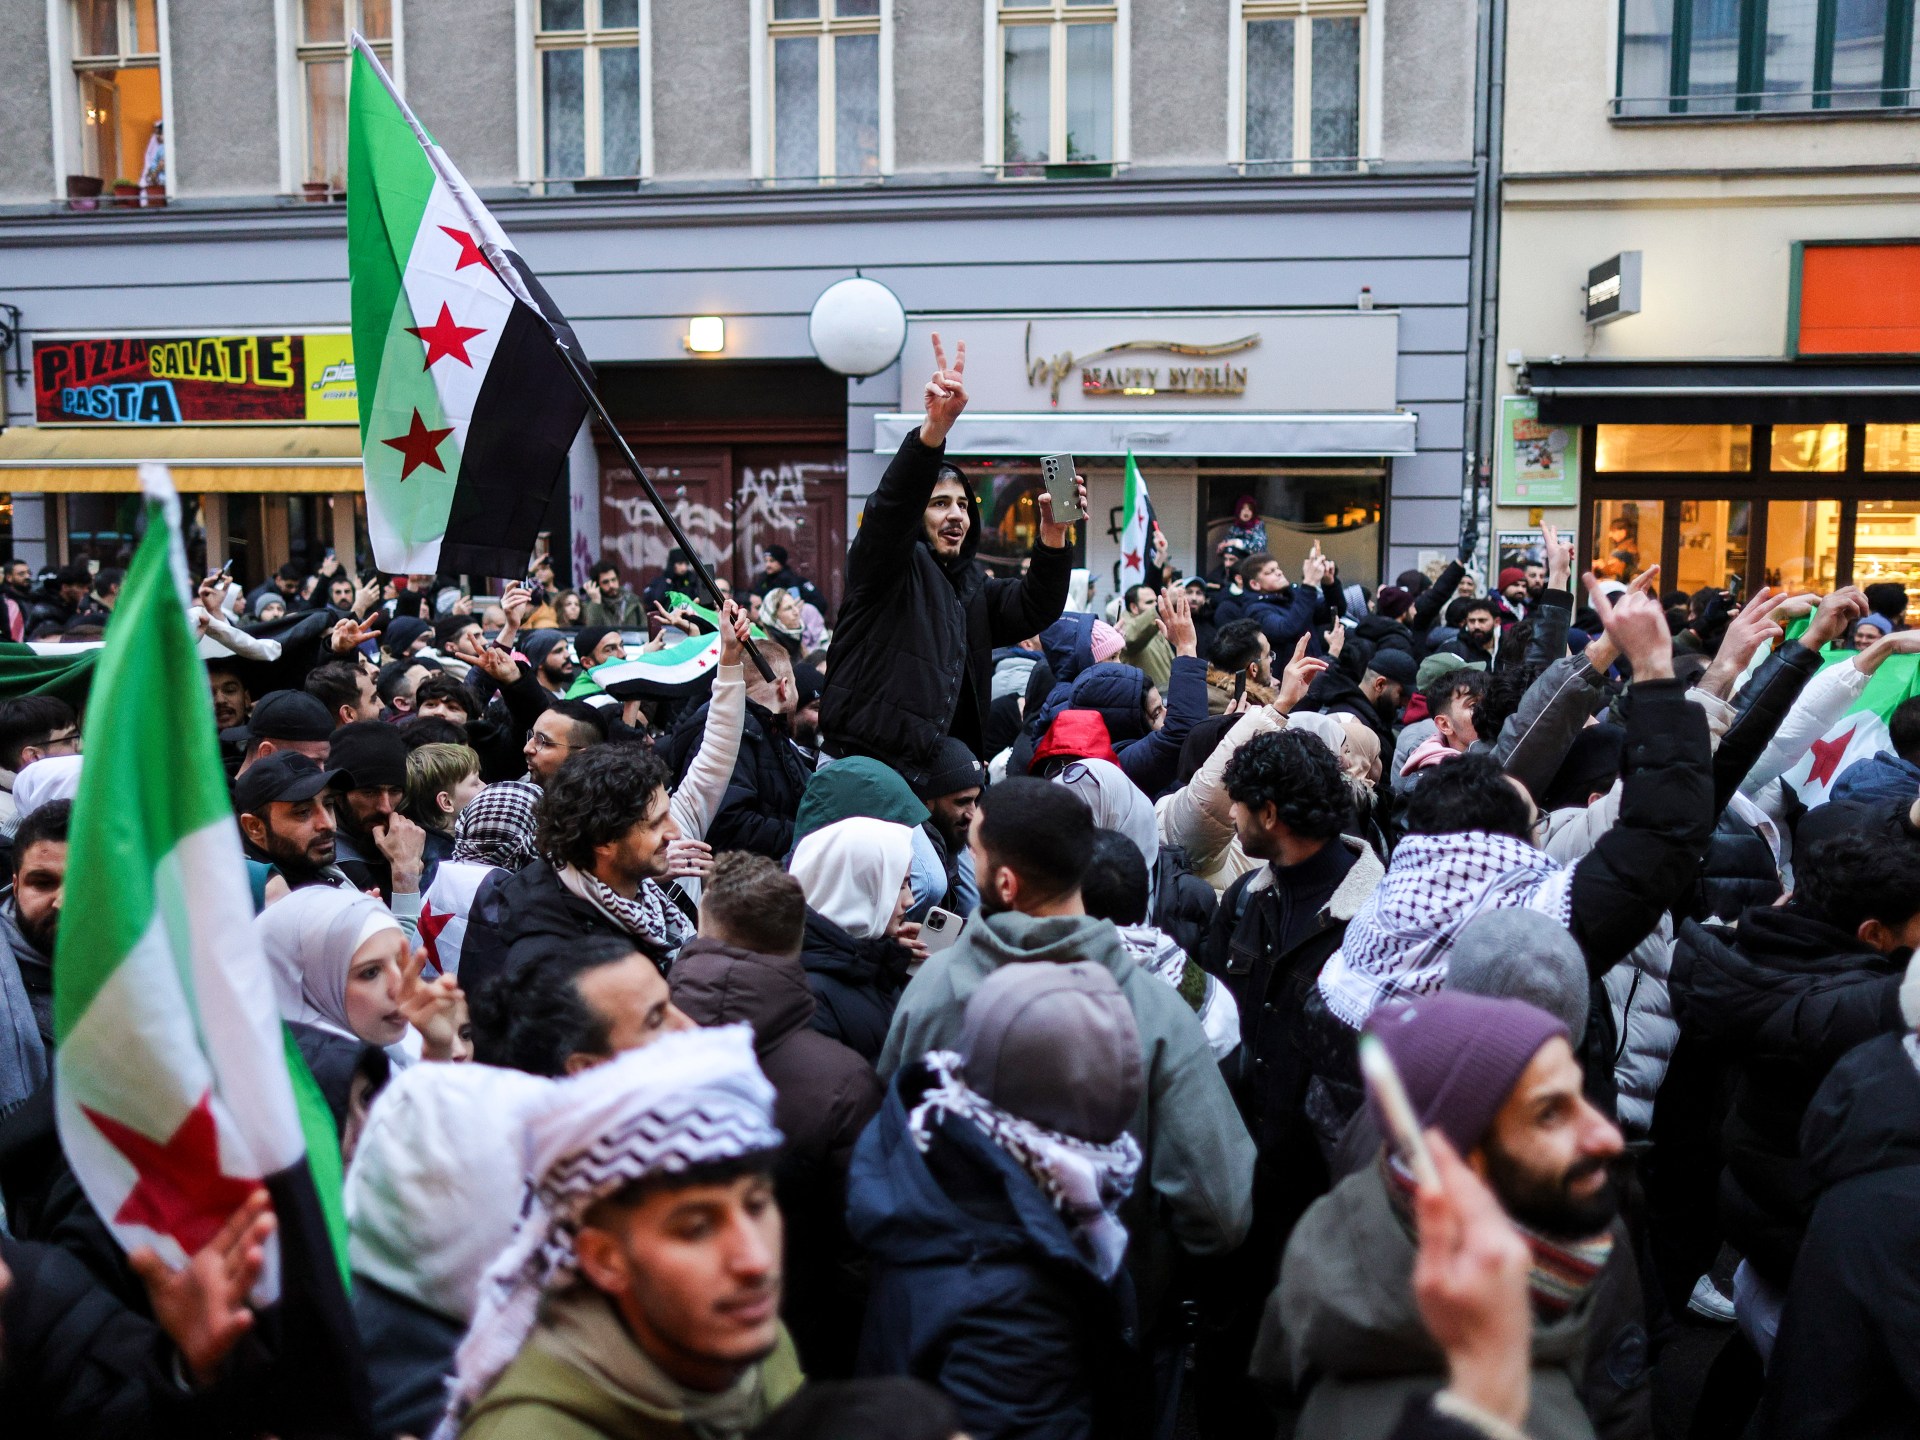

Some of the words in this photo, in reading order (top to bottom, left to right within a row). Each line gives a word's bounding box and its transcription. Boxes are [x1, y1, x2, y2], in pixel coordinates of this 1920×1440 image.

[37, 339, 148, 396] PIZZA
[150, 335, 295, 388] SALATE
[1082, 367, 1160, 388] BEAUTY
[62, 380, 182, 423] PASTA
